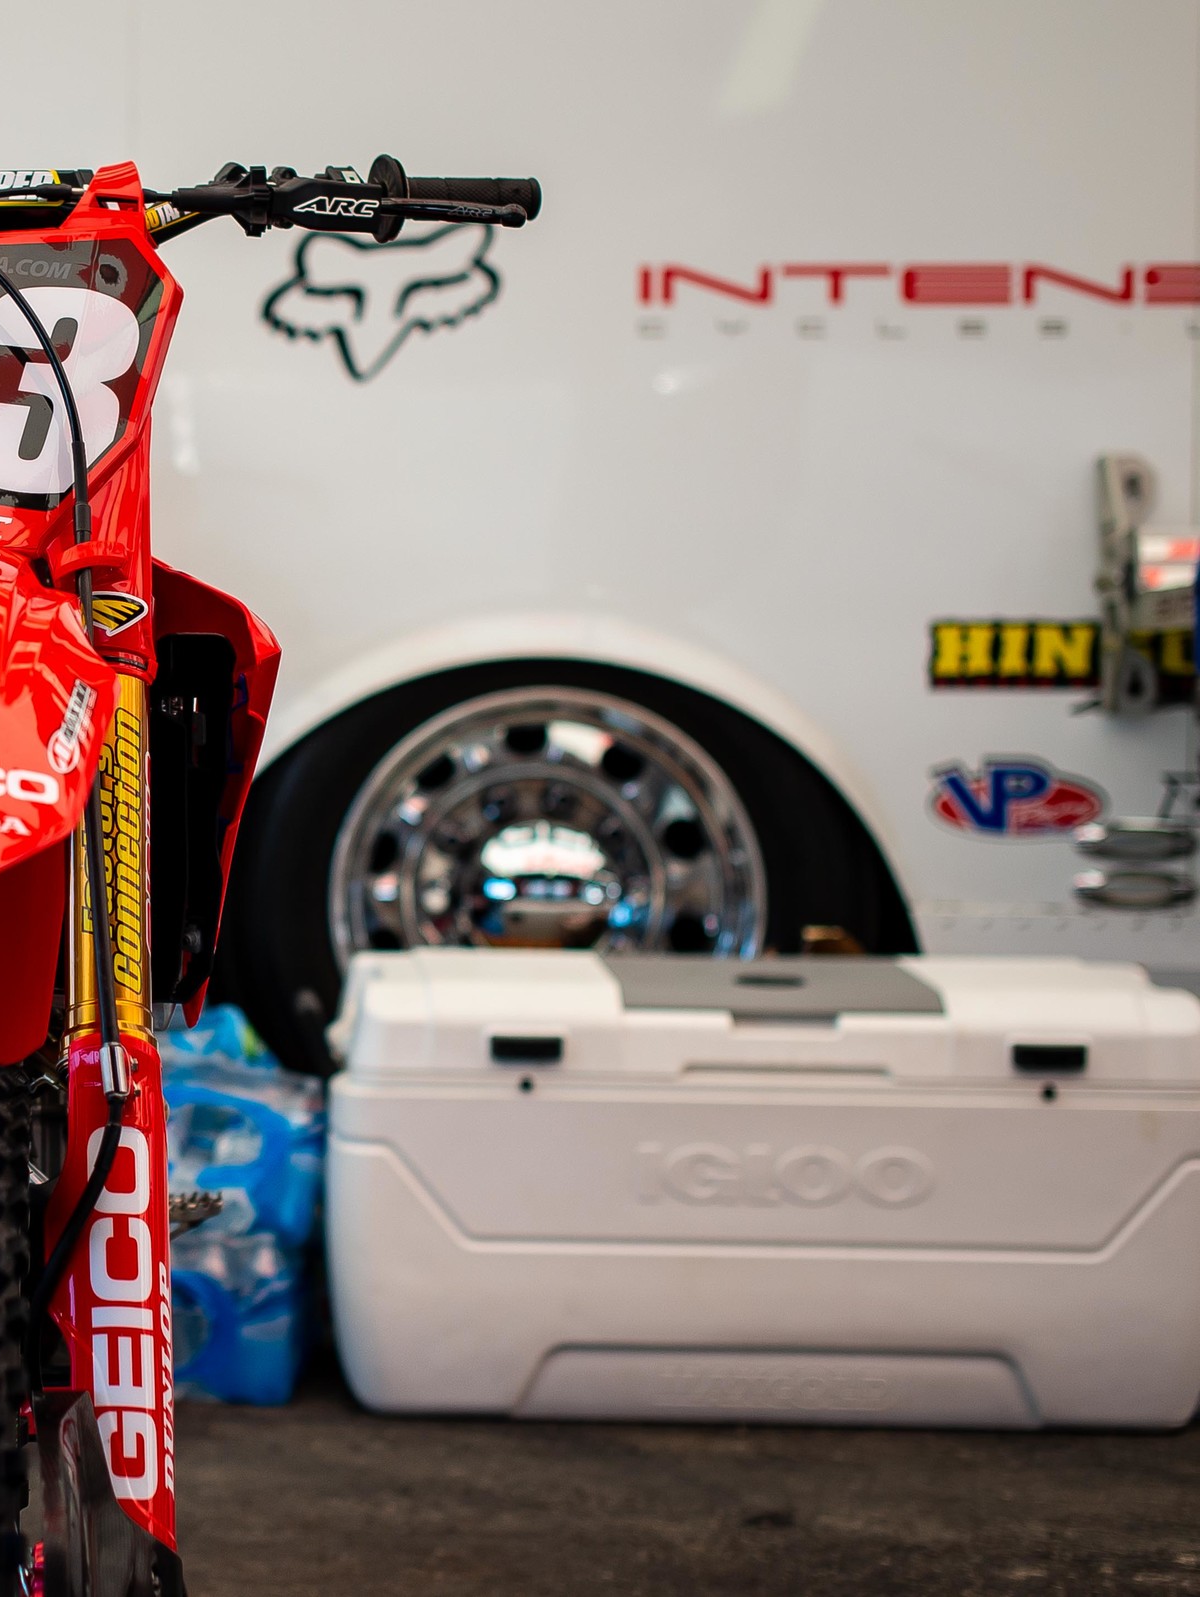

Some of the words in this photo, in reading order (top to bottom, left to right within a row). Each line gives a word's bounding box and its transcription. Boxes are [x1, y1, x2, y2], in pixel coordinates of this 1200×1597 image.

[293, 196, 380, 218] ARC
[938, 761, 1050, 833] VP
[633, 1141, 938, 1210] IGLOO
[87, 1126, 158, 1500] GEICO
[159, 1261, 175, 1500] DUNLOP
